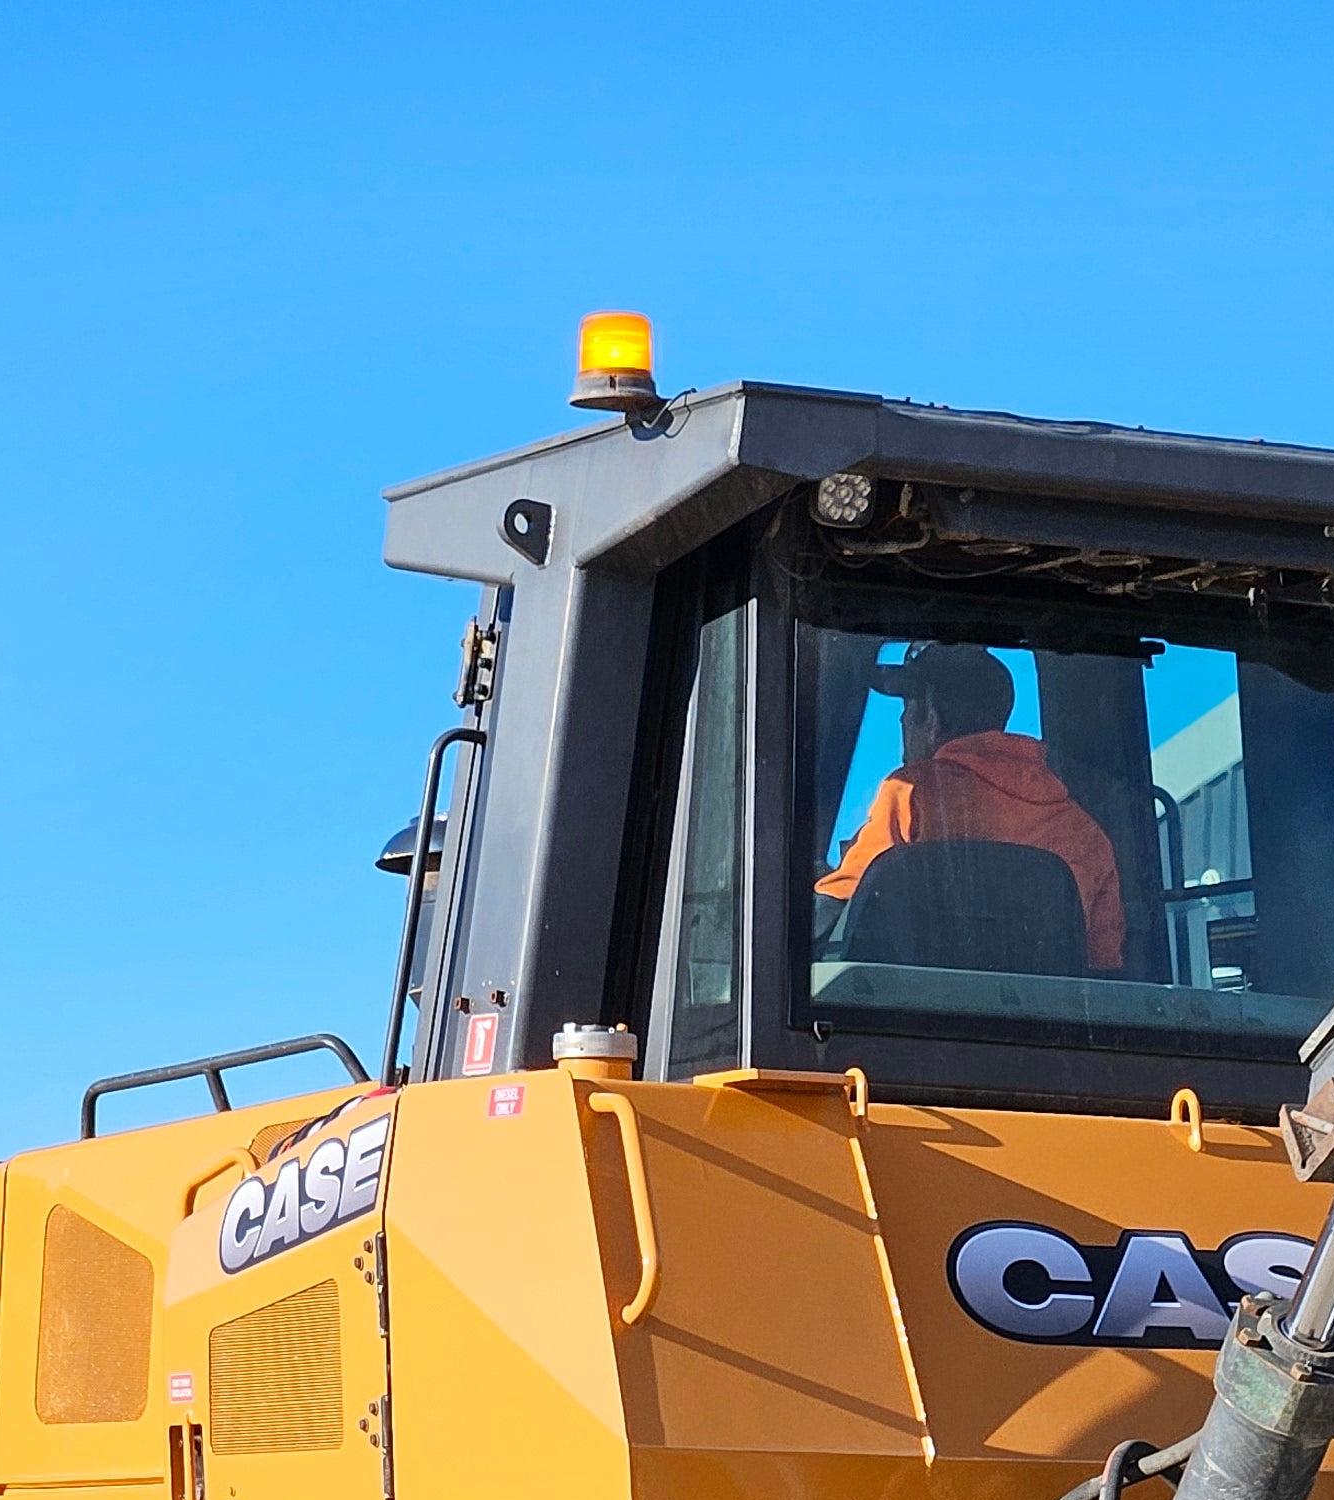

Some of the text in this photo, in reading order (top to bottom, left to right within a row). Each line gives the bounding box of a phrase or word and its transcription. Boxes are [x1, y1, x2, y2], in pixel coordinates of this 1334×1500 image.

[494, 1088, 519, 1102] DIESEL
[495, 1101, 516, 1115] ONLY
[220, 1115, 390, 1271] CASE
